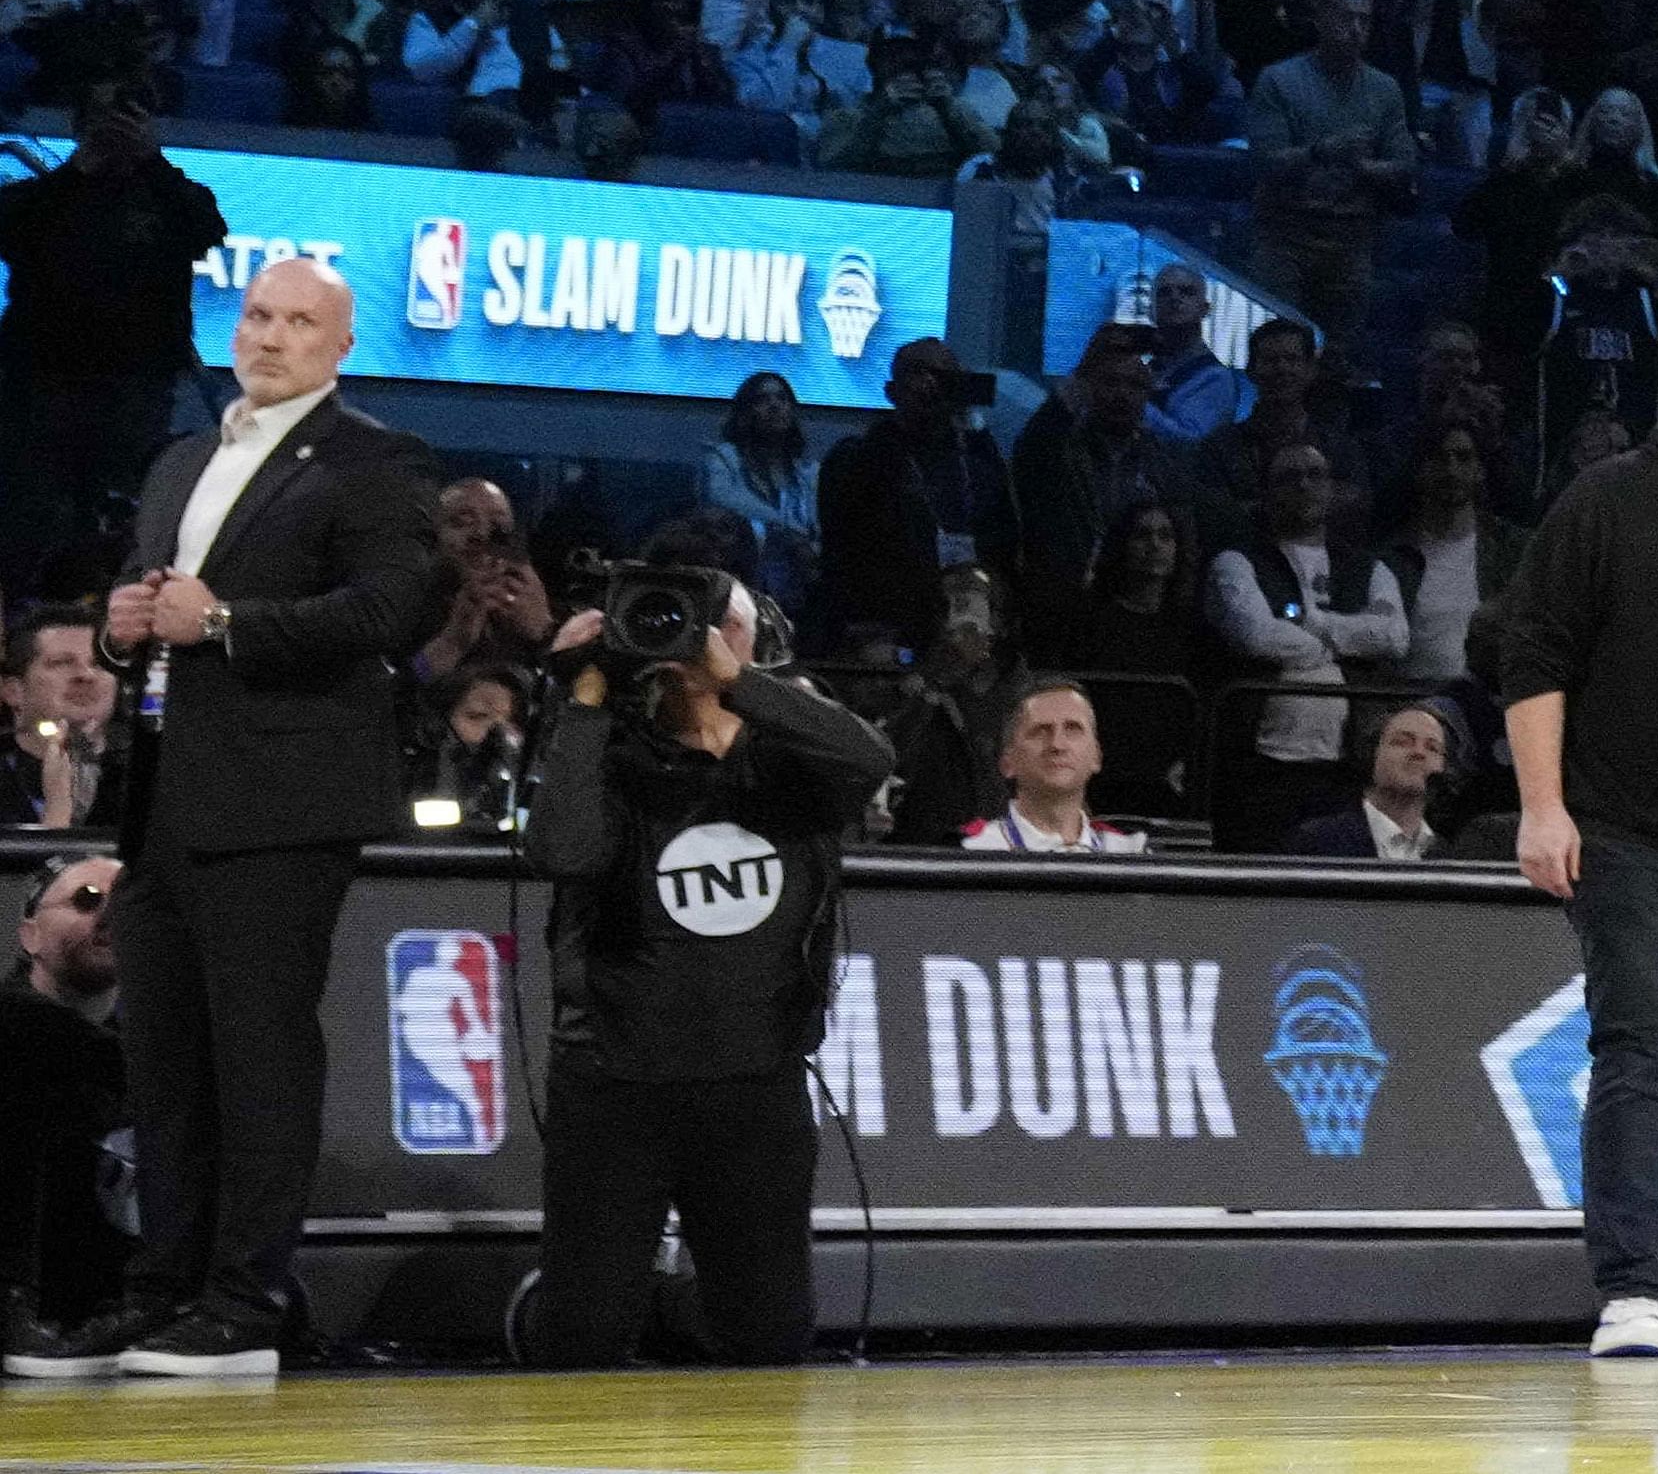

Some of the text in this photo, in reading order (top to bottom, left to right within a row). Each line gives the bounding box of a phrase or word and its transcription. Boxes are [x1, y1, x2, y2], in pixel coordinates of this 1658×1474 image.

[482, 233, 806, 345] SLAM DUNK
[658, 851, 783, 908] TNT
[922, 956, 1240, 1142] DUNK
